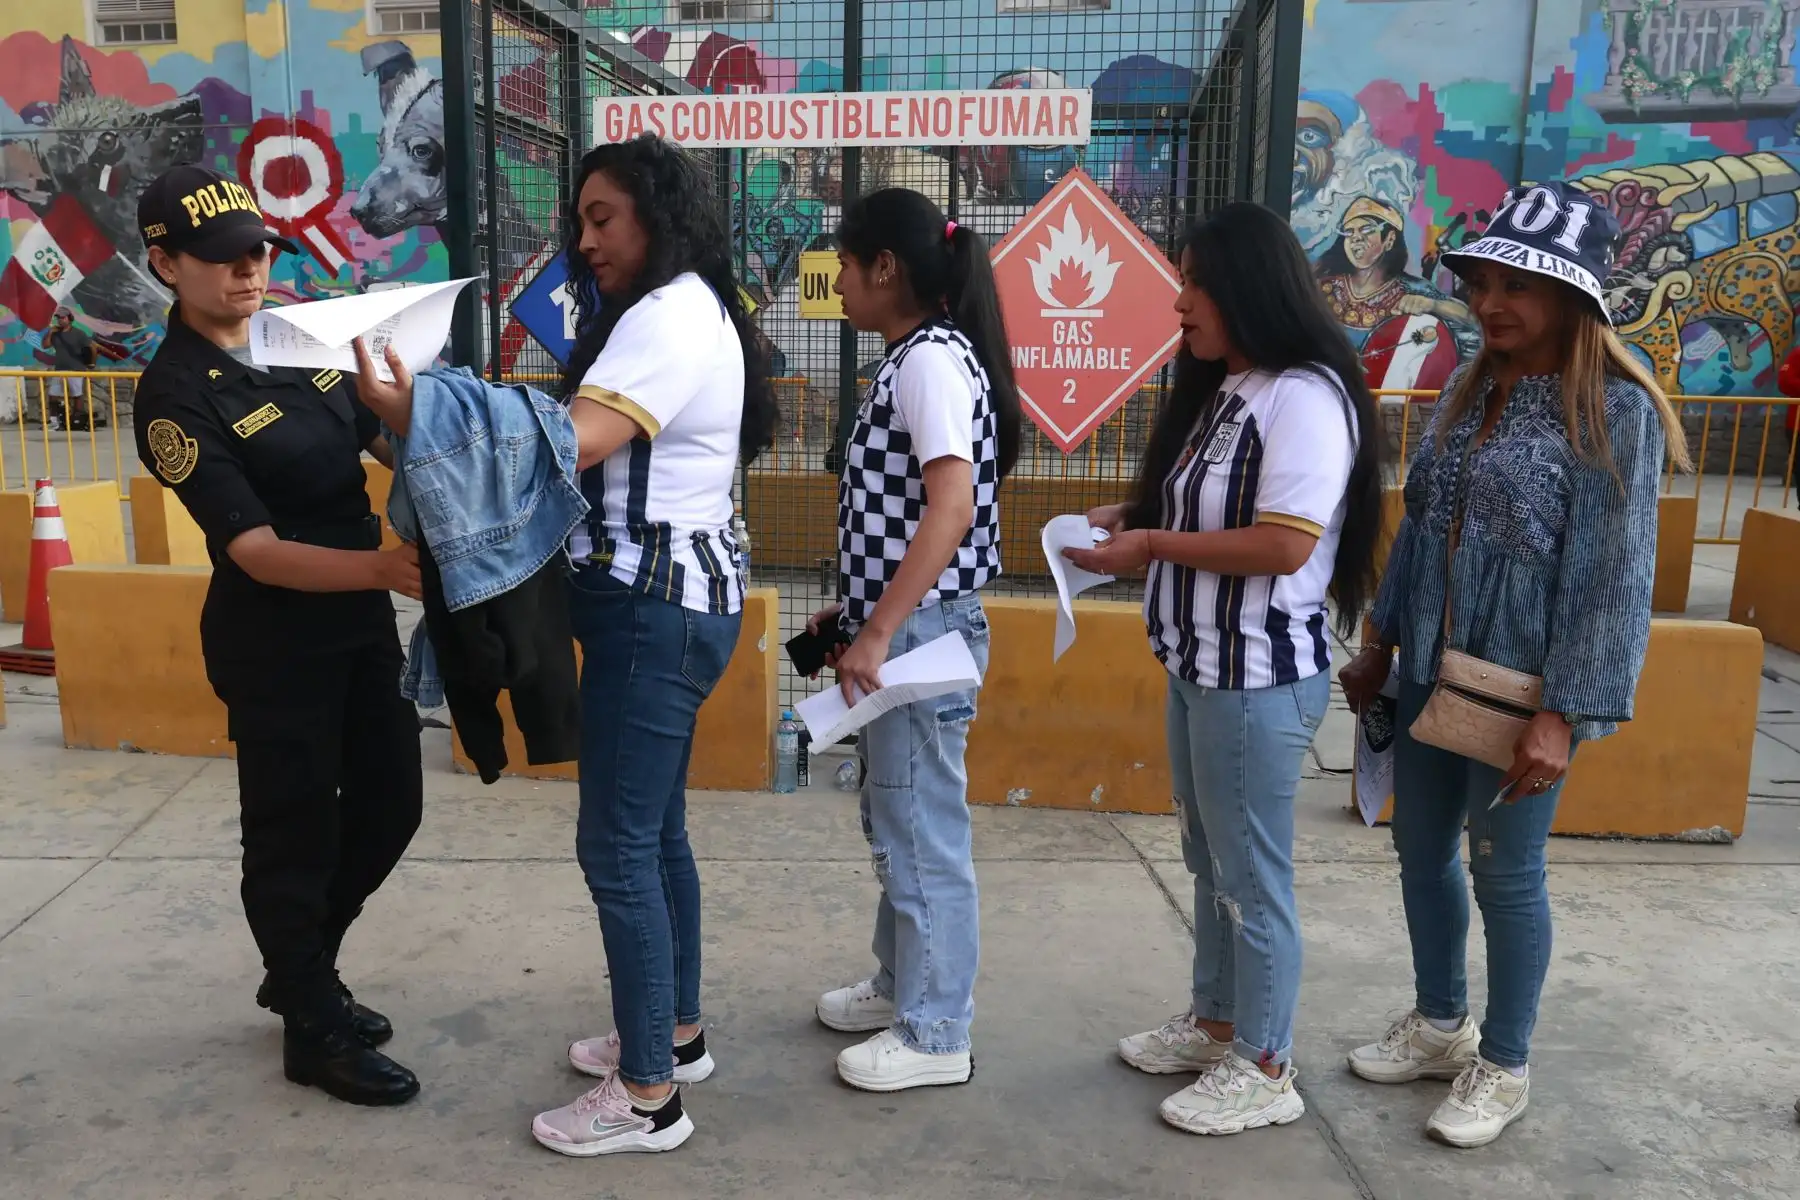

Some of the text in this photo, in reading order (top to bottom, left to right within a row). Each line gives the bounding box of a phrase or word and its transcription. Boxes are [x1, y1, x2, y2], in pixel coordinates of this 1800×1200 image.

[605, 95, 1079, 142] GAS COMBUSTIBLE NO FUMAR
[144, 222, 168, 239] PERU
[1536, 252, 1593, 293] LIMA
[803, 272, 829, 301] UN
[1052, 319, 1094, 346] GAS
[1010, 346, 1132, 370] INFLAMABLE
[1062, 378, 1077, 404] 2
